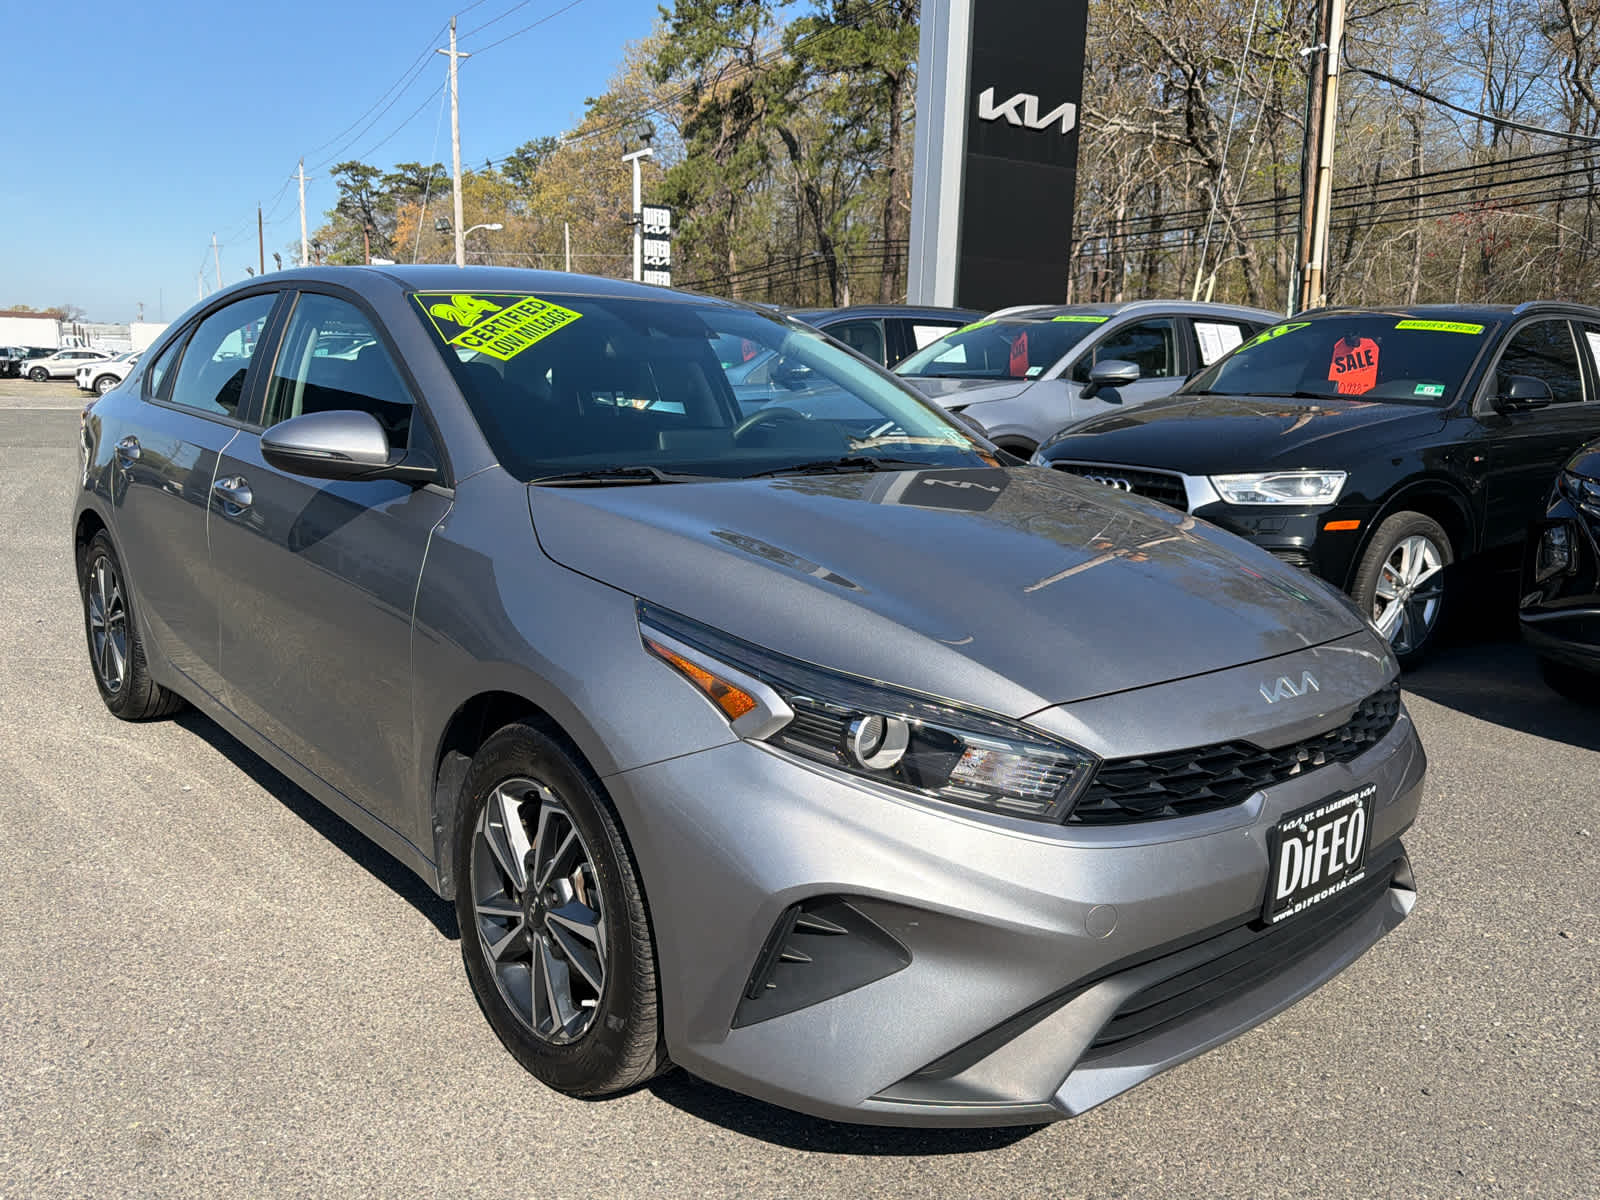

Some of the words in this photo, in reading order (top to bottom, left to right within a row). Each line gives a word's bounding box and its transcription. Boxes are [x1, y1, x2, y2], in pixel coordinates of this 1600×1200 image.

[979, 87, 1076, 134] KIA
[430, 295, 503, 327] 24
[461, 301, 547, 348] CERTIFIED
[488, 333, 526, 356] LOW
[514, 308, 572, 340] MILEAGE
[1335, 349, 1374, 373] SALE
[1259, 671, 1320, 703] KIA
[1325, 793, 1359, 815] LAKEWOOD
[1273, 872, 1365, 923] www.DIFEOKIA.com
